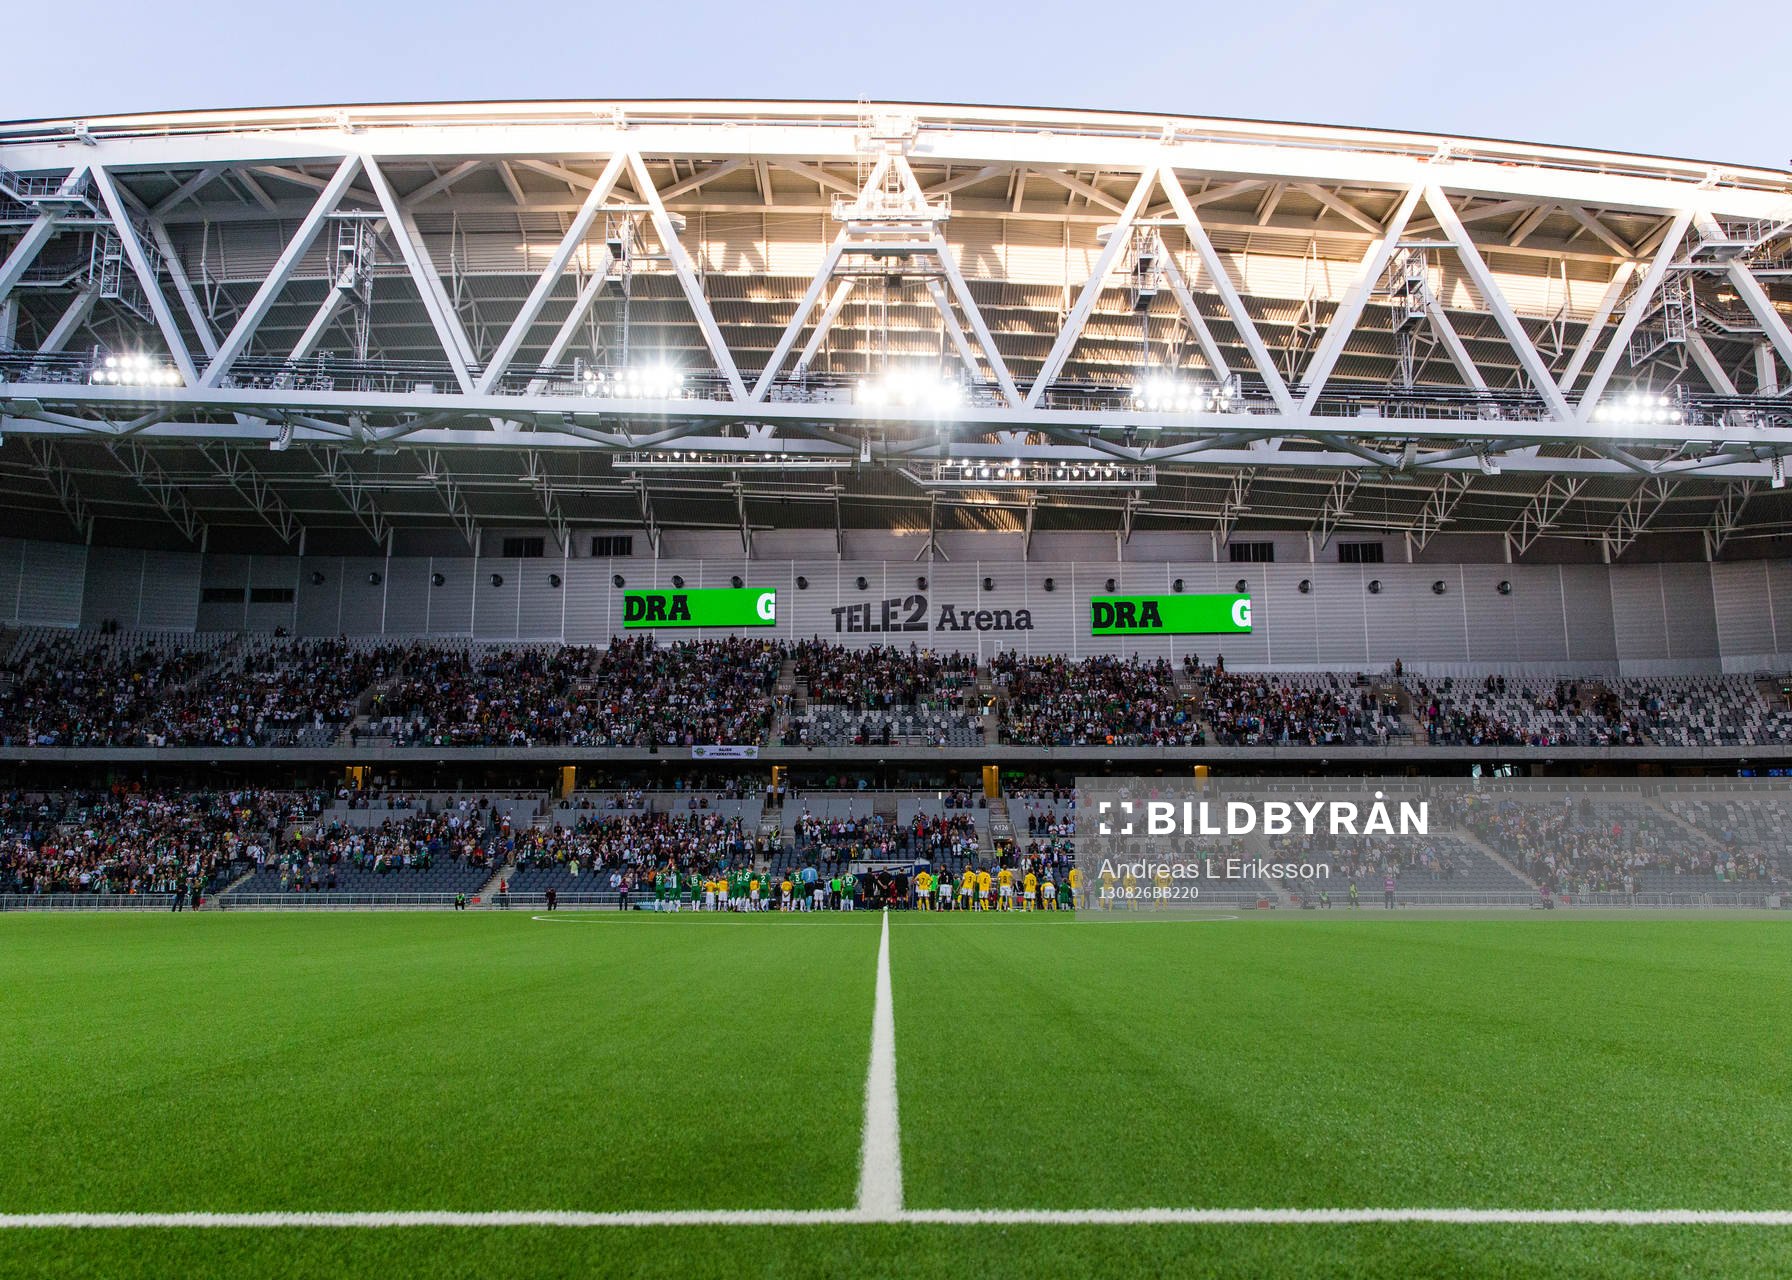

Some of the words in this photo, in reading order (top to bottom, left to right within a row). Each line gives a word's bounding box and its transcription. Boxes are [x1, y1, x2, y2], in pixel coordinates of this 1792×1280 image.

[624, 595, 691, 621] DRA
[757, 593, 775, 620] G
[831, 595, 928, 632] TELE2
[935, 604, 1034, 631] Arena
[1092, 601, 1162, 628] DRA
[1232, 599, 1252, 627] G
